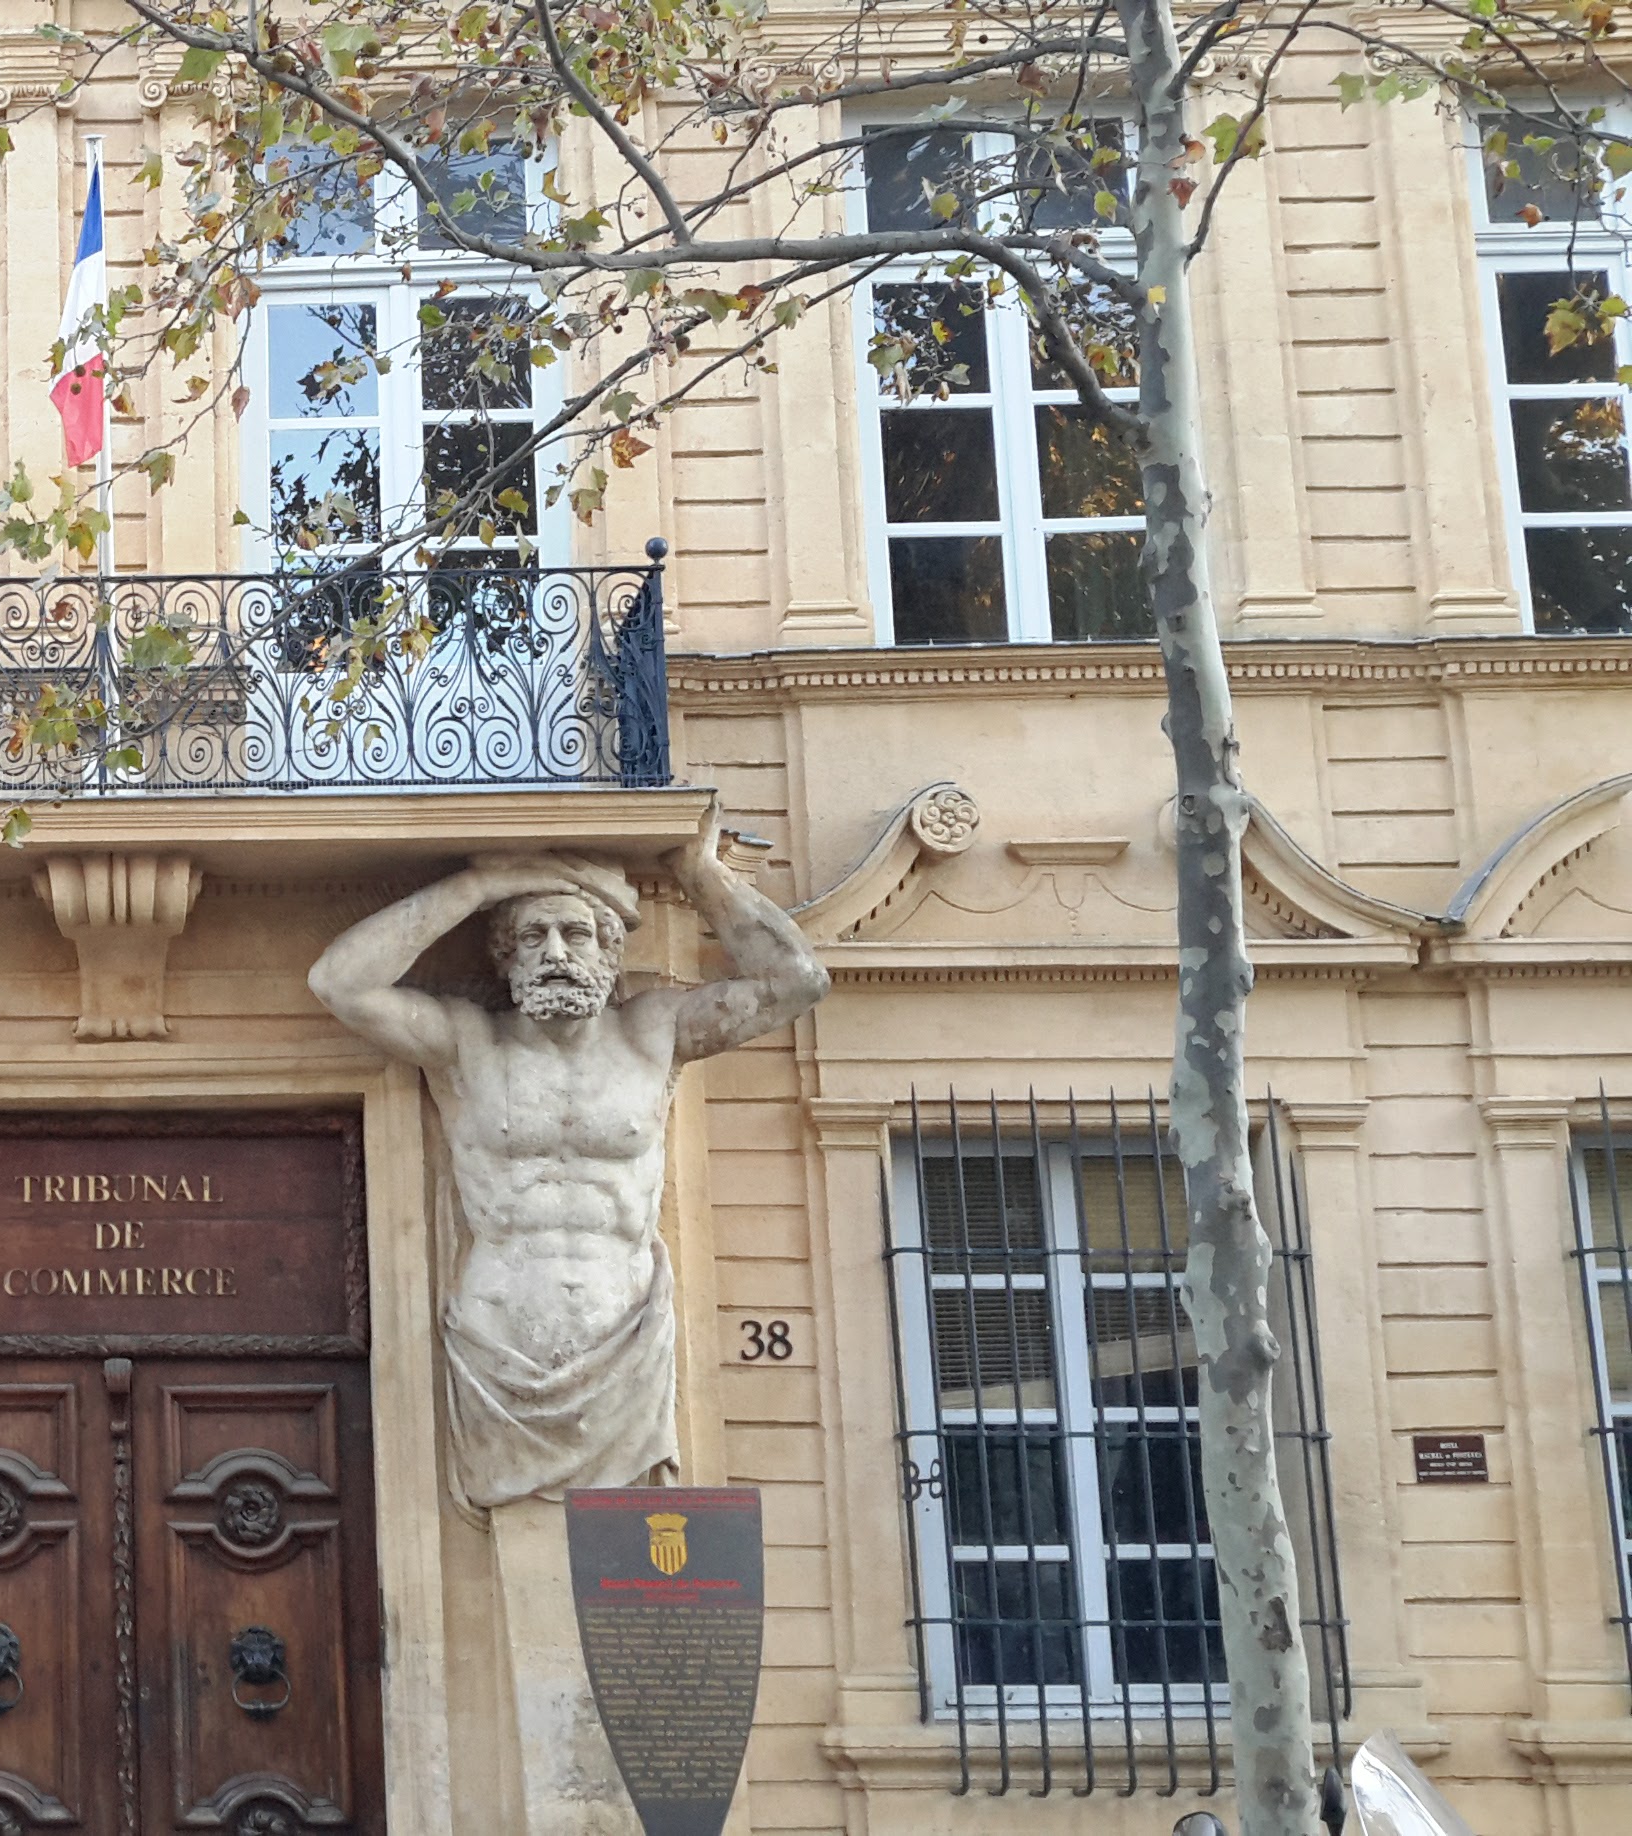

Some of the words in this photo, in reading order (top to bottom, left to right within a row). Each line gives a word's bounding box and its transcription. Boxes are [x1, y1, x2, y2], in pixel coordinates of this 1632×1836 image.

[15, 1174, 224, 1204] TRIBUNAL
[93, 1221, 146, 1250] DE
[3, 1267, 238, 1297] COMMERCE
[740, 1320, 793, 1361] 38
